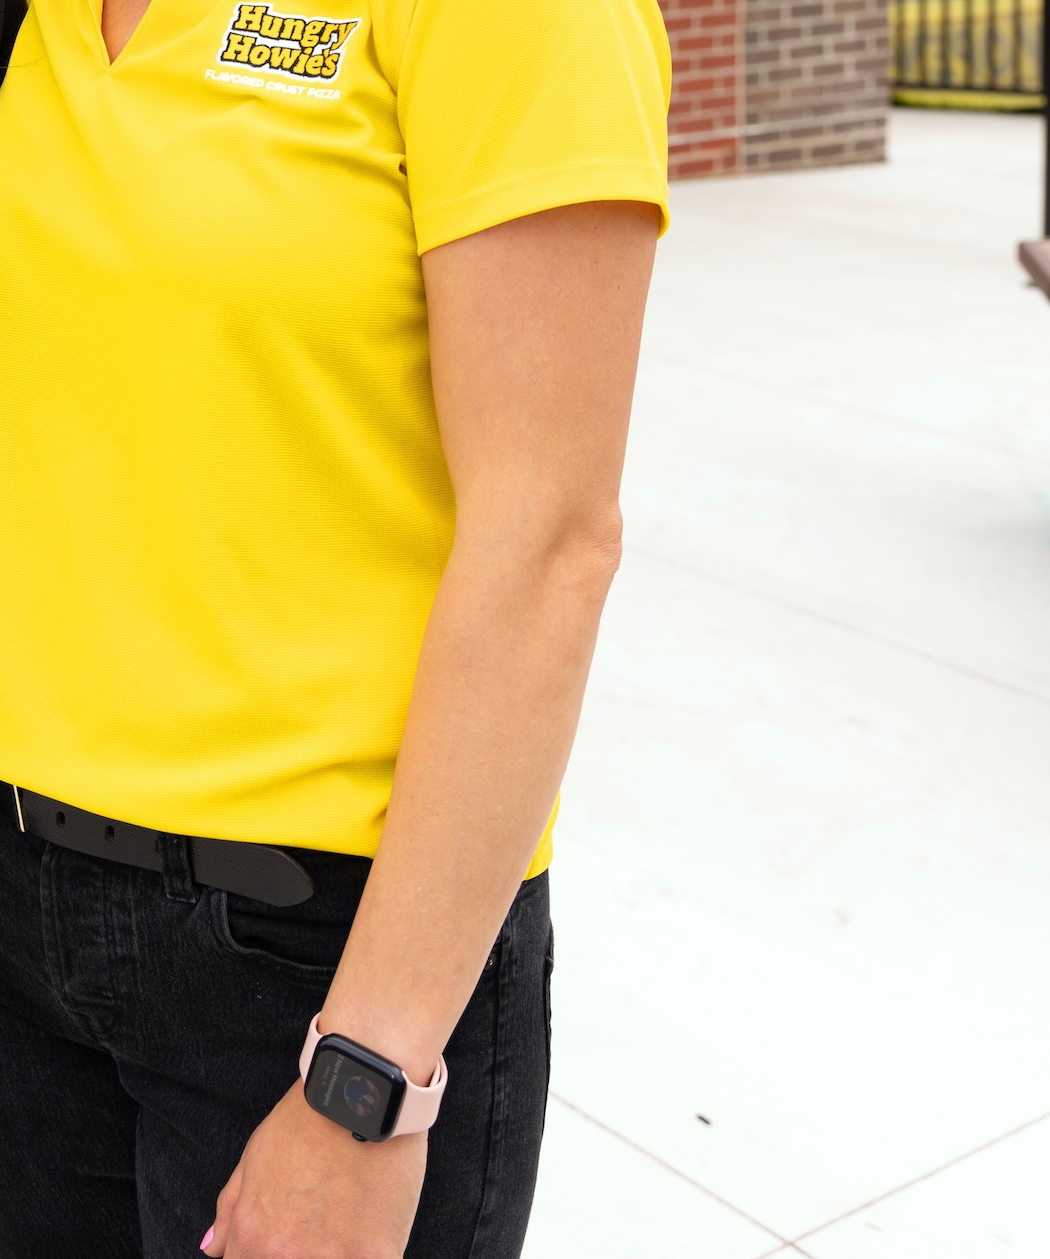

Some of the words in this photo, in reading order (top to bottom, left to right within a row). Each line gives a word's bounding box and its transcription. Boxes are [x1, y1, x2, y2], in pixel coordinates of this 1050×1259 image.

[231, 4, 359, 51] Hungry
[220, 31, 341, 80] Howie's
[204, 68, 265, 88] FLAVORED
[265, 80, 307, 96] CRUST
[306, 87, 341, 100] PIZZA
[333, 1058, 343, 1074] New
[323, 1073, 338, 1107] Messages
